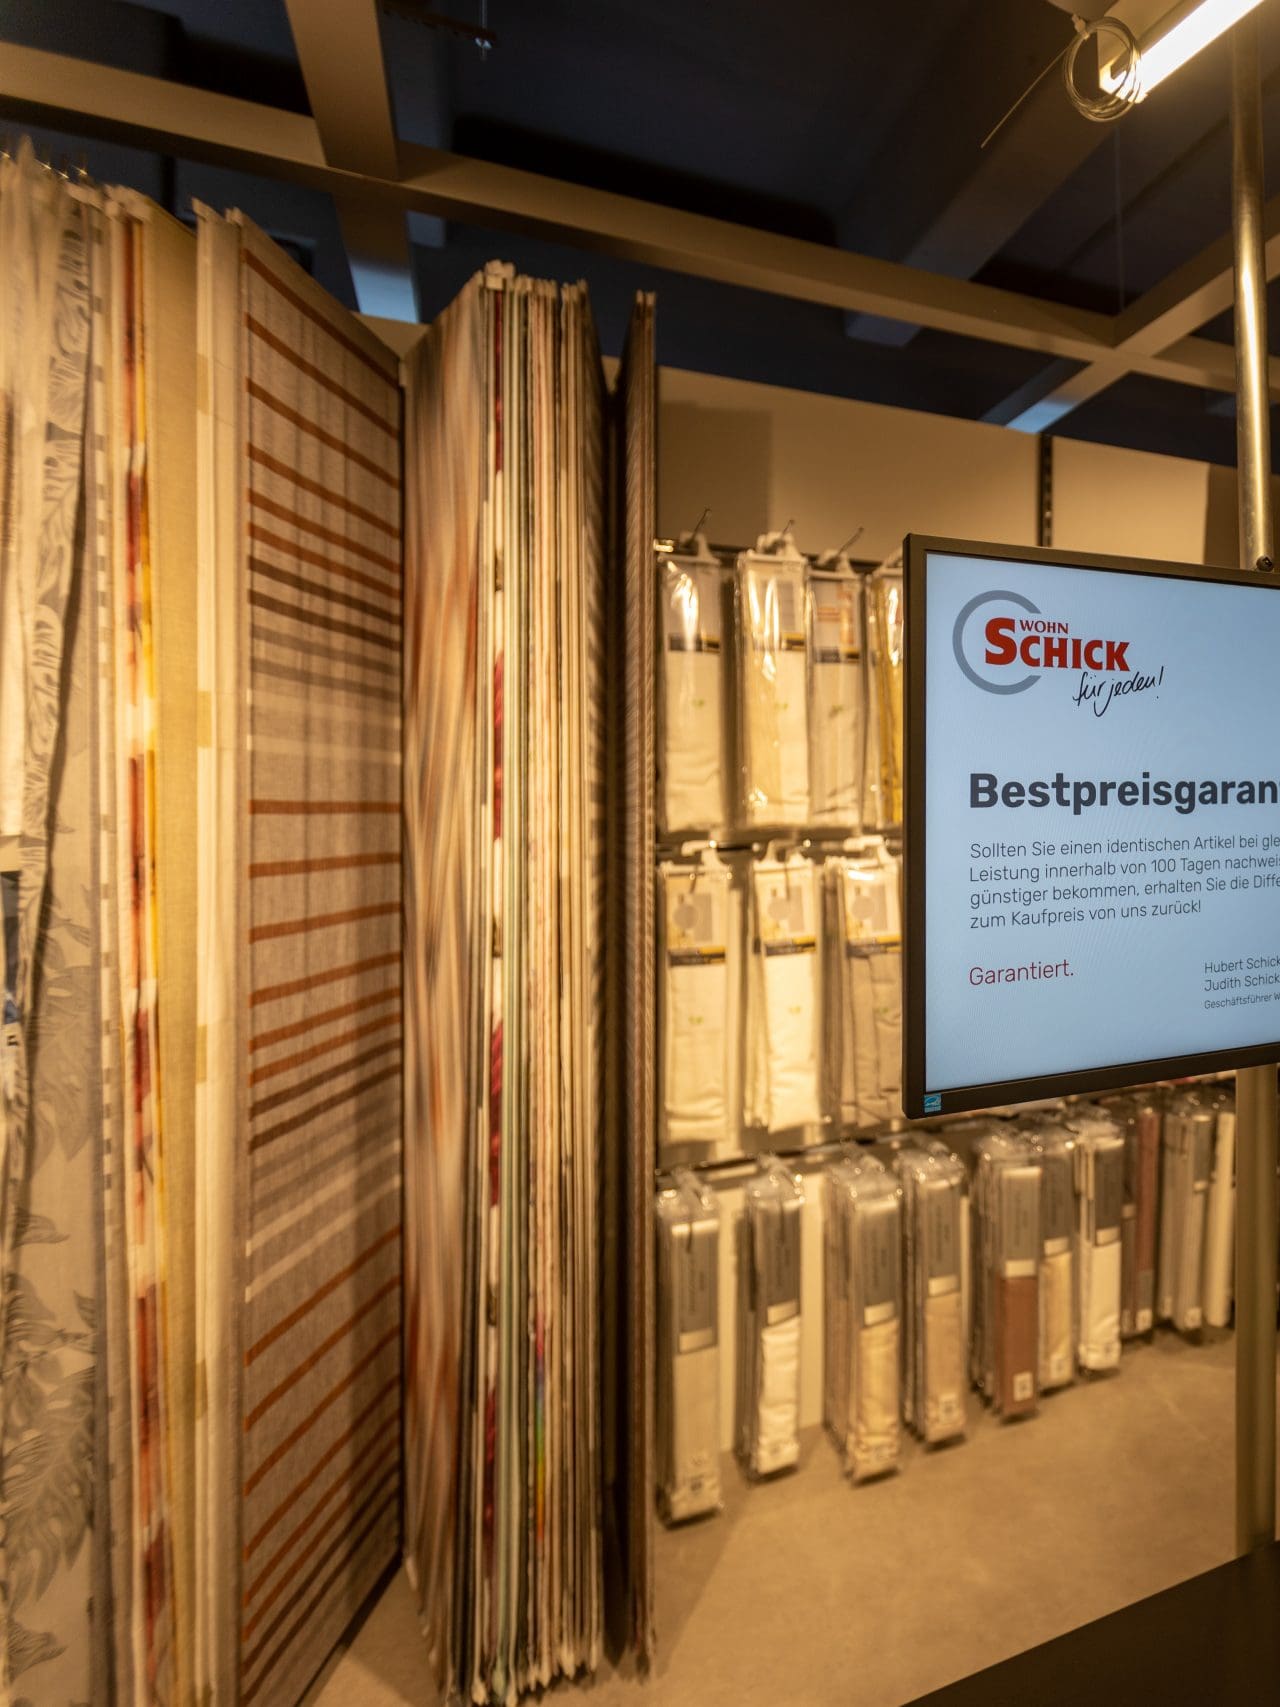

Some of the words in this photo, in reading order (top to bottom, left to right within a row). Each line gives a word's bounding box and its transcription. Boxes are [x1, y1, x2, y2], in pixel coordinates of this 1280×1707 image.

[1019, 619, 1069, 635] WOHN
[984, 617, 1130, 672] SCHICK
[1072, 671, 1105, 707] für
[1094, 665, 1165, 717] jeden!
[969, 842, 1027, 858] Sollten
[1031, 841, 1056, 856] Sie
[1059, 840, 1103, 855] einen
[1106, 836, 1191, 853] identischen
[1192, 835, 1236, 851] Artikel
[1238, 834, 1259, 849] bei
[969, 864, 1040, 883] Leistung
[1044, 862, 1116, 878] innerhalb
[1120, 862, 1148, 874] von
[1151, 859, 1177, 873] 100
[1180, 858, 1221, 874] Tagen
[969, 887, 1049, 908] günstiger
[1051, 883, 1140, 901] bekommen,
[1143, 878, 1202, 896] erhalten
[1205, 877, 1227, 892] Sie
[1229, 876, 1250, 890] die
[969, 913, 1006, 929] zum
[1010, 906, 1085, 927] Kaufpreis
[1089, 906, 1116, 921] von
[1120, 904, 1147, 918] uns
[1151, 900, 1202, 916] zurück!
[969, 959, 1075, 985] Garantiert.
[1204, 959, 1244, 974] Hubert
[1204, 977, 1242, 992] Judith
[1204, 994, 1272, 1009] Geschäftsführer
